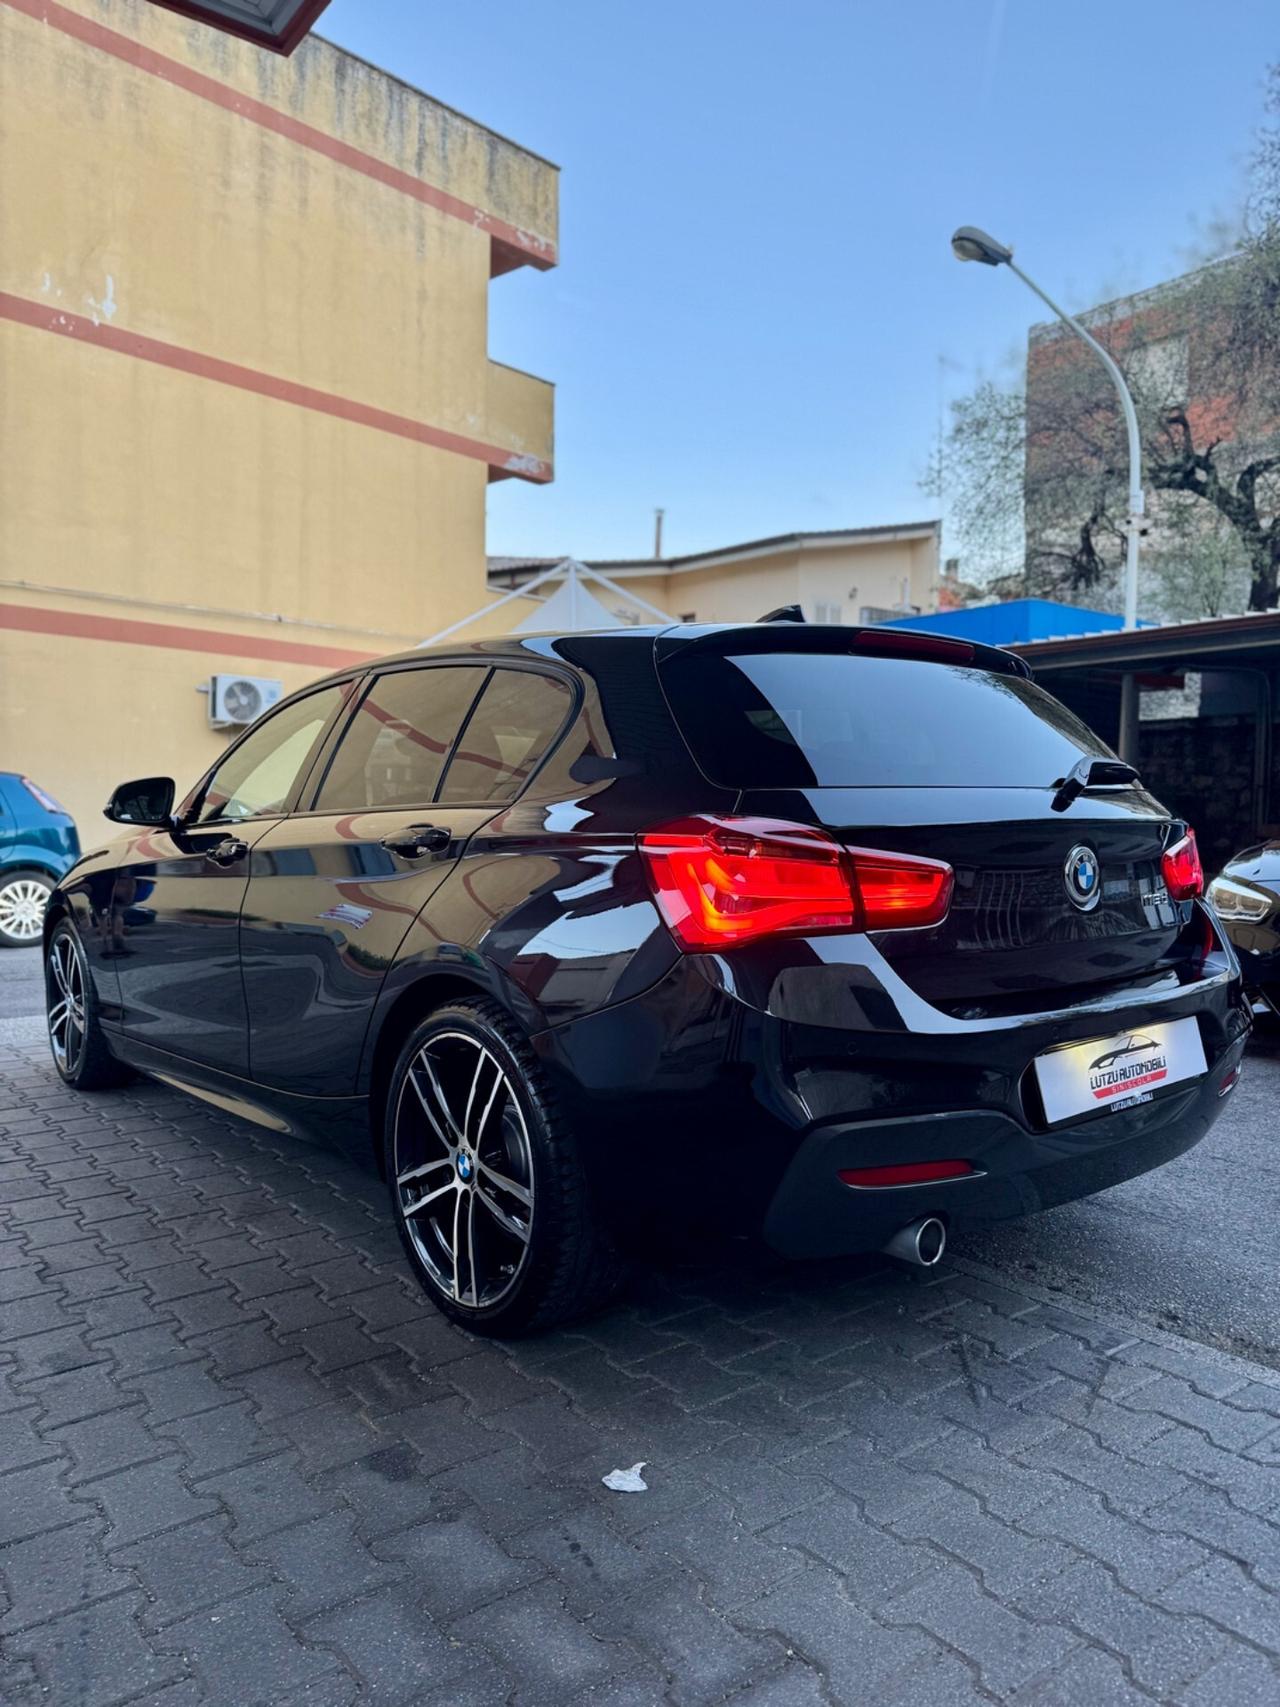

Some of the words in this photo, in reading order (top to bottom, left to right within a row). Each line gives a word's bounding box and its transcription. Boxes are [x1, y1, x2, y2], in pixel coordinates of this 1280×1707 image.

[1090, 1070, 1119, 1090] LUTZU
[1119, 1056, 1167, 1080] AUTOMOBILI
[1111, 1076, 1152, 1094] SINISCOLA
